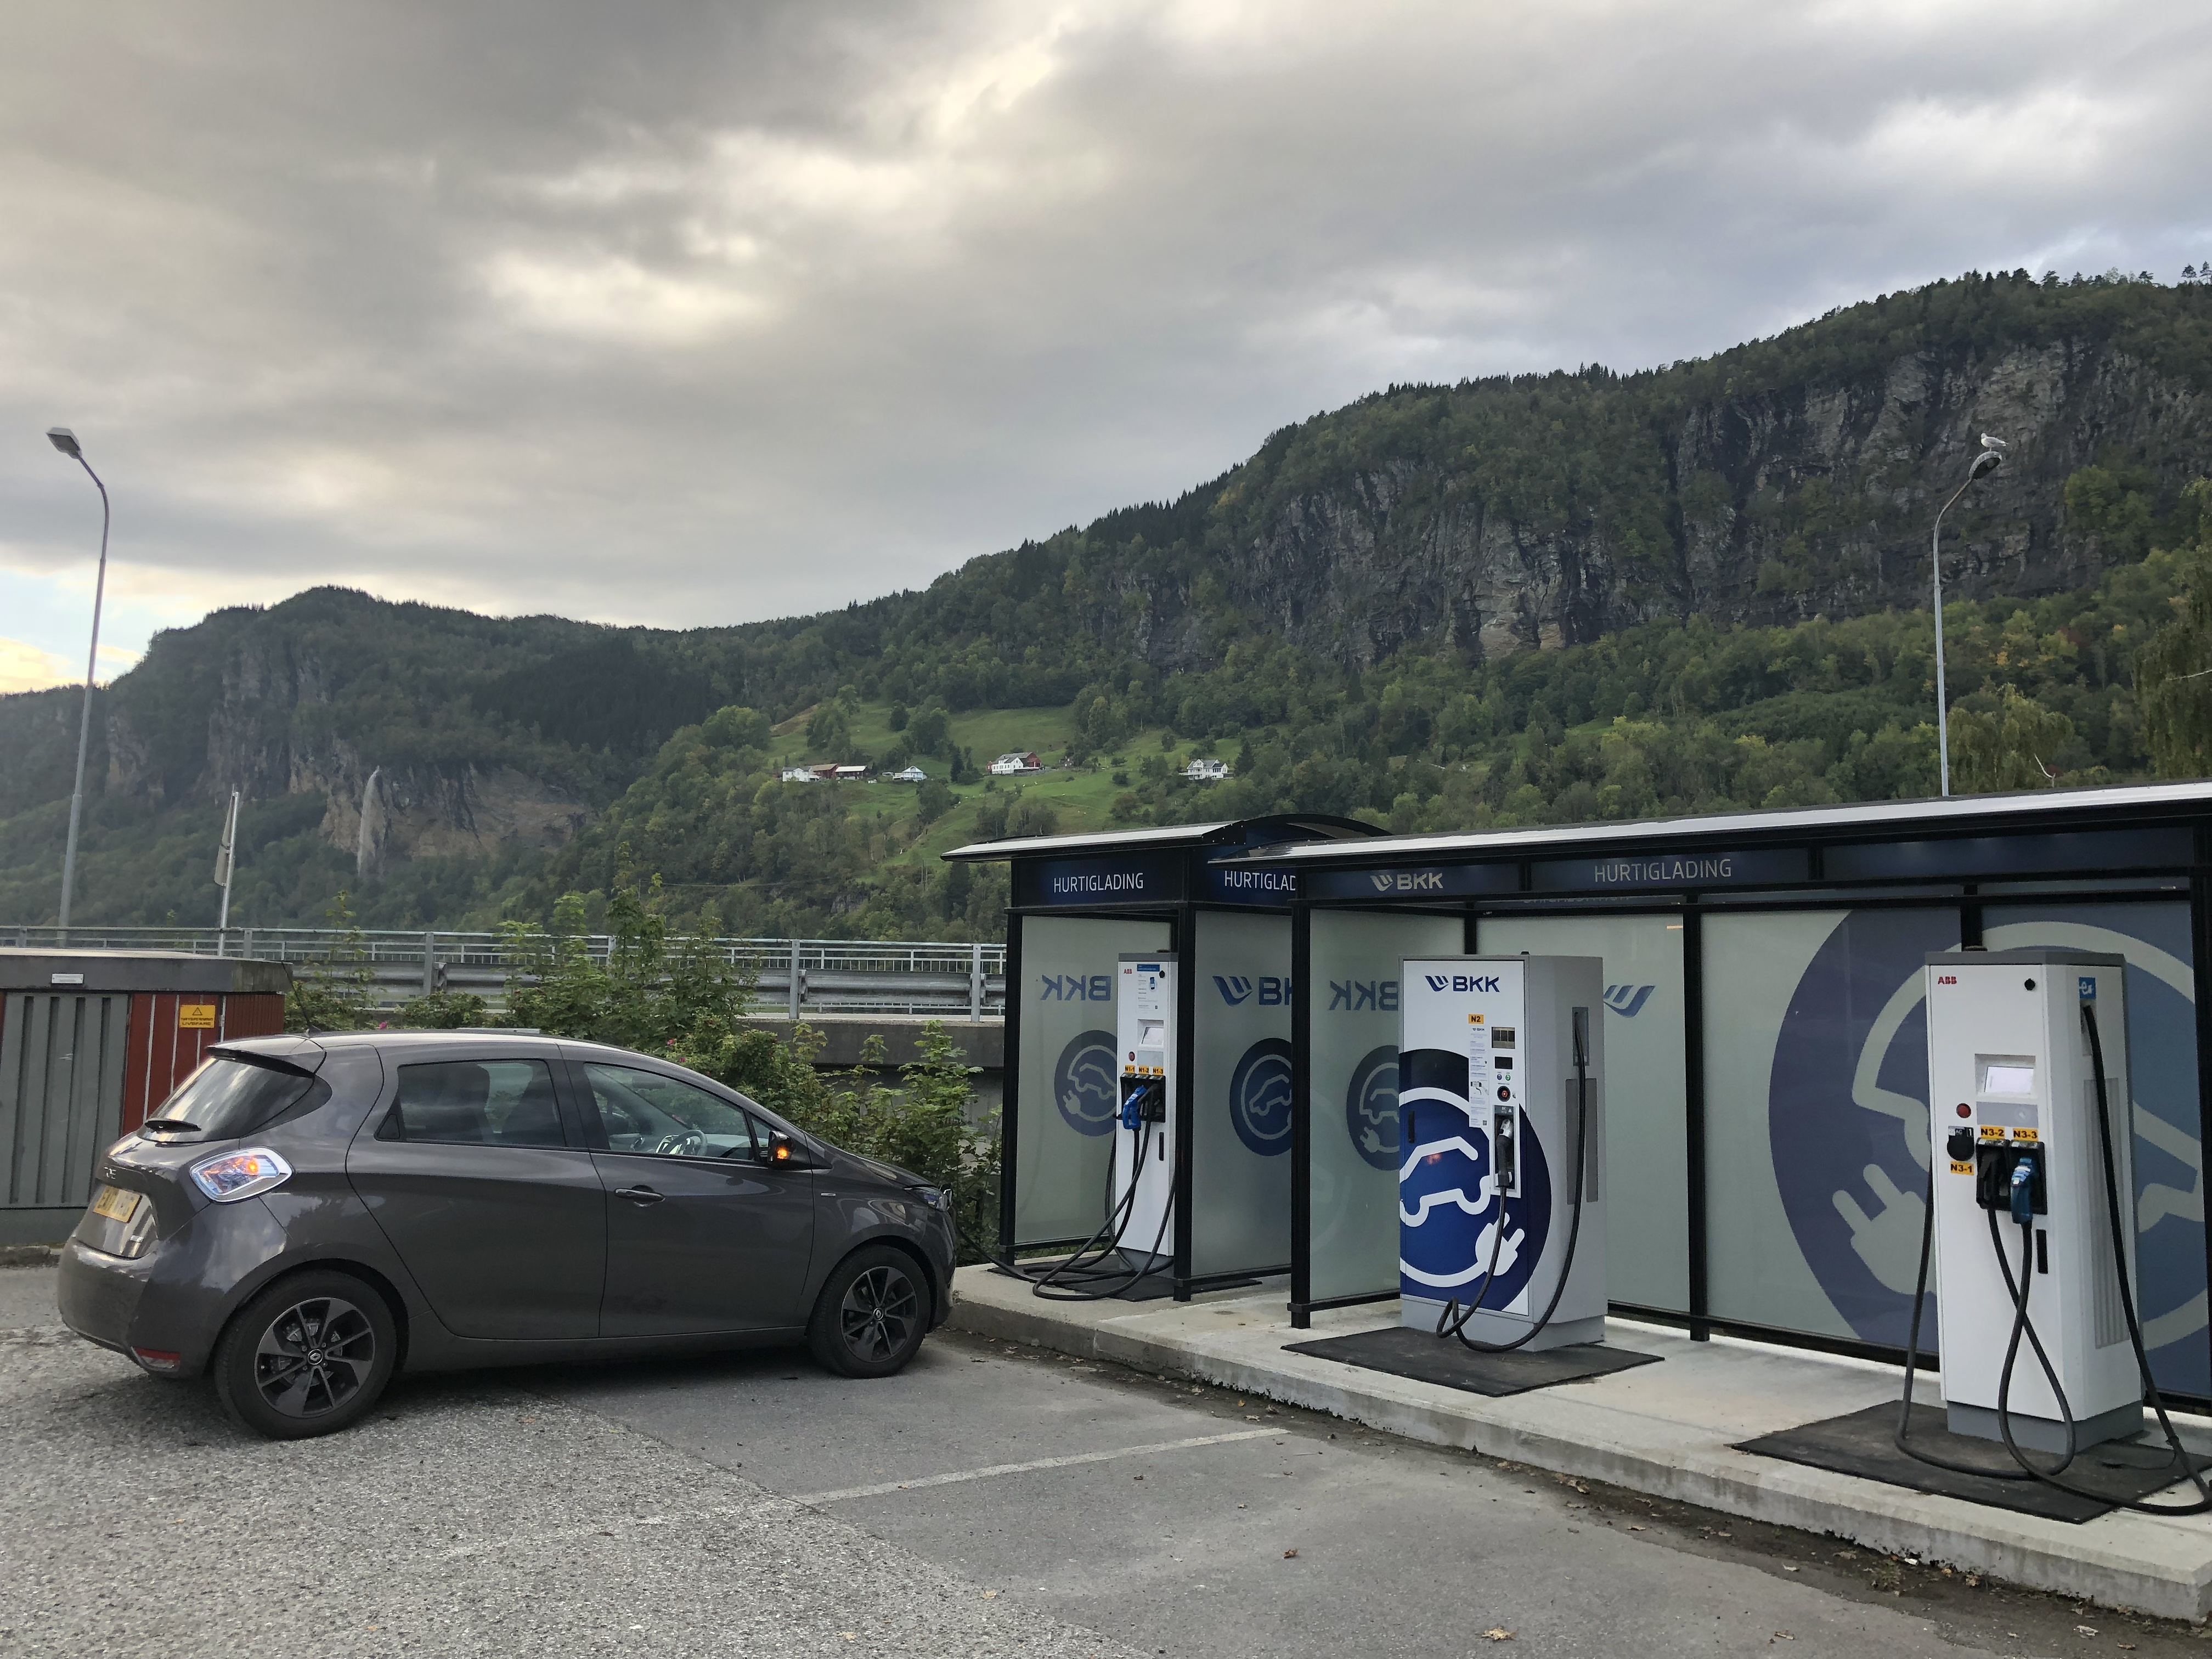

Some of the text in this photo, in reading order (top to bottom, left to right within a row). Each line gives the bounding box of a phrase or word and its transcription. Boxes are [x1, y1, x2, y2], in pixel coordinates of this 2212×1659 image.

[1594, 859, 1731, 883] HURTIGLADING
[1054, 872, 1143, 893] HURTIGLADING
[1397, 872, 1443, 890] BKK
[1453, 975, 1500, 992] BKK
[1938, 976, 1957, 985] ABB
[1980, 1128, 2004, 1137] N3-2
[2013, 1130, 2038, 1139] N3-3
[1950, 1164, 1973, 1173] N3-1
